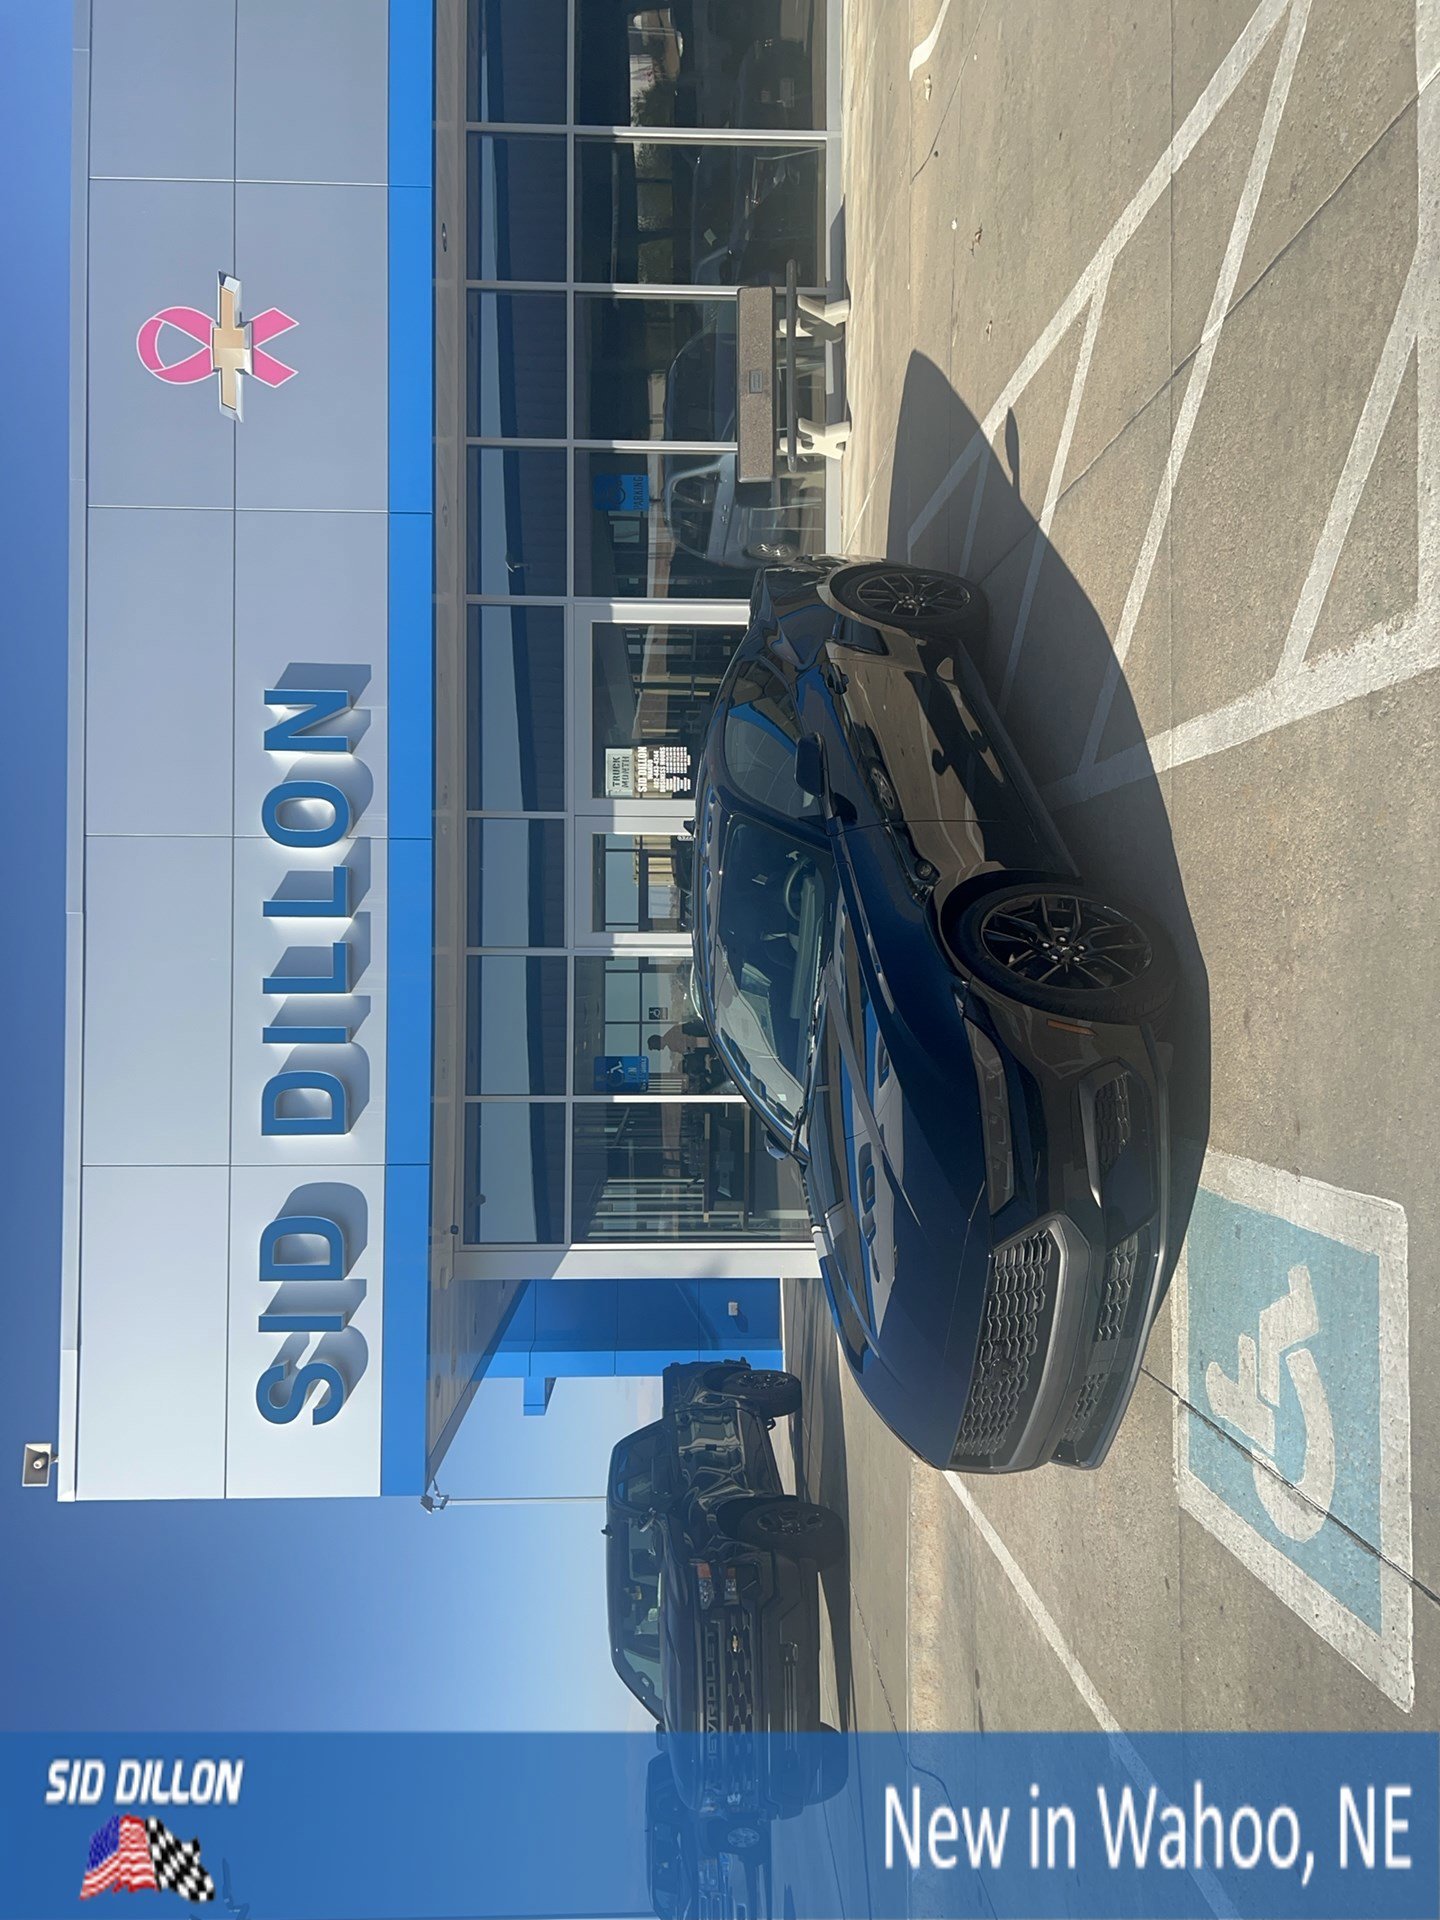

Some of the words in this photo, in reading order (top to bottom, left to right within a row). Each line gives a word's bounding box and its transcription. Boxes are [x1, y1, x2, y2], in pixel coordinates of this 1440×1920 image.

[633, 476, 643, 510] PARKING
[612, 756, 620, 787] TRUCK
[621, 756, 629, 788] MONTH
[637, 746, 647, 776] DILLON
[637, 777, 647, 793] SID
[261, 688, 353, 1136] DILLON
[256, 1215, 347, 1425] SID
